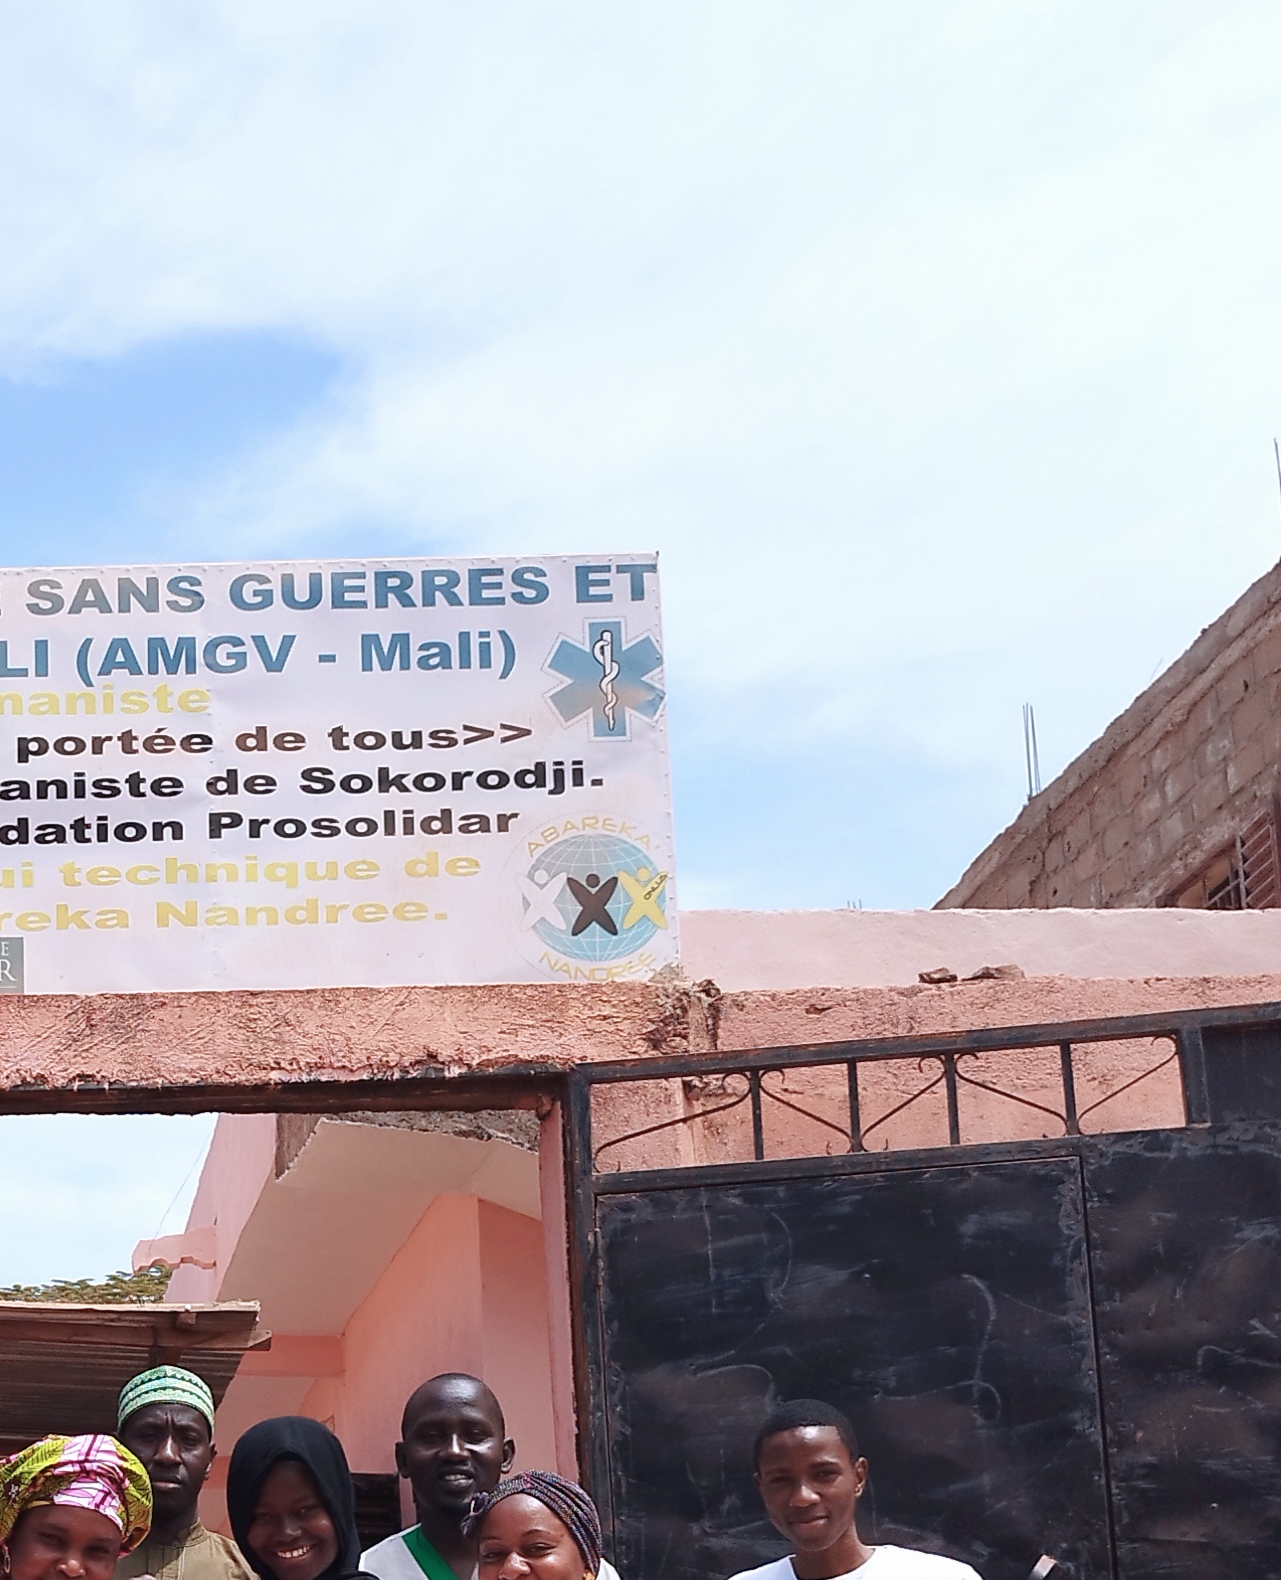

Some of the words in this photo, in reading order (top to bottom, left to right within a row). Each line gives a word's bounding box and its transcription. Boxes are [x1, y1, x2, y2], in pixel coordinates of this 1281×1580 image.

[25, 575, 205, 616] SANS
[229, 566, 550, 612] GUERRES
[574, 563, 658, 604] ET
[76, 634, 297, 688] (AMGV
[360, 629, 516, 680] Mali)
[16, 727, 214, 764] portée
[234, 725, 307, 753] de
[205, 768, 278, 797] de
[299, 759, 604, 796] Sokorodji.
[208, 807, 521, 840] Prosolidar
[527, 816, 651, 857] ABAREKA
[59, 854, 380, 889] technique
[404, 850, 480, 878] de
[156, 897, 447, 928] Nandree.
[538, 951, 657, 982] NANDREE
